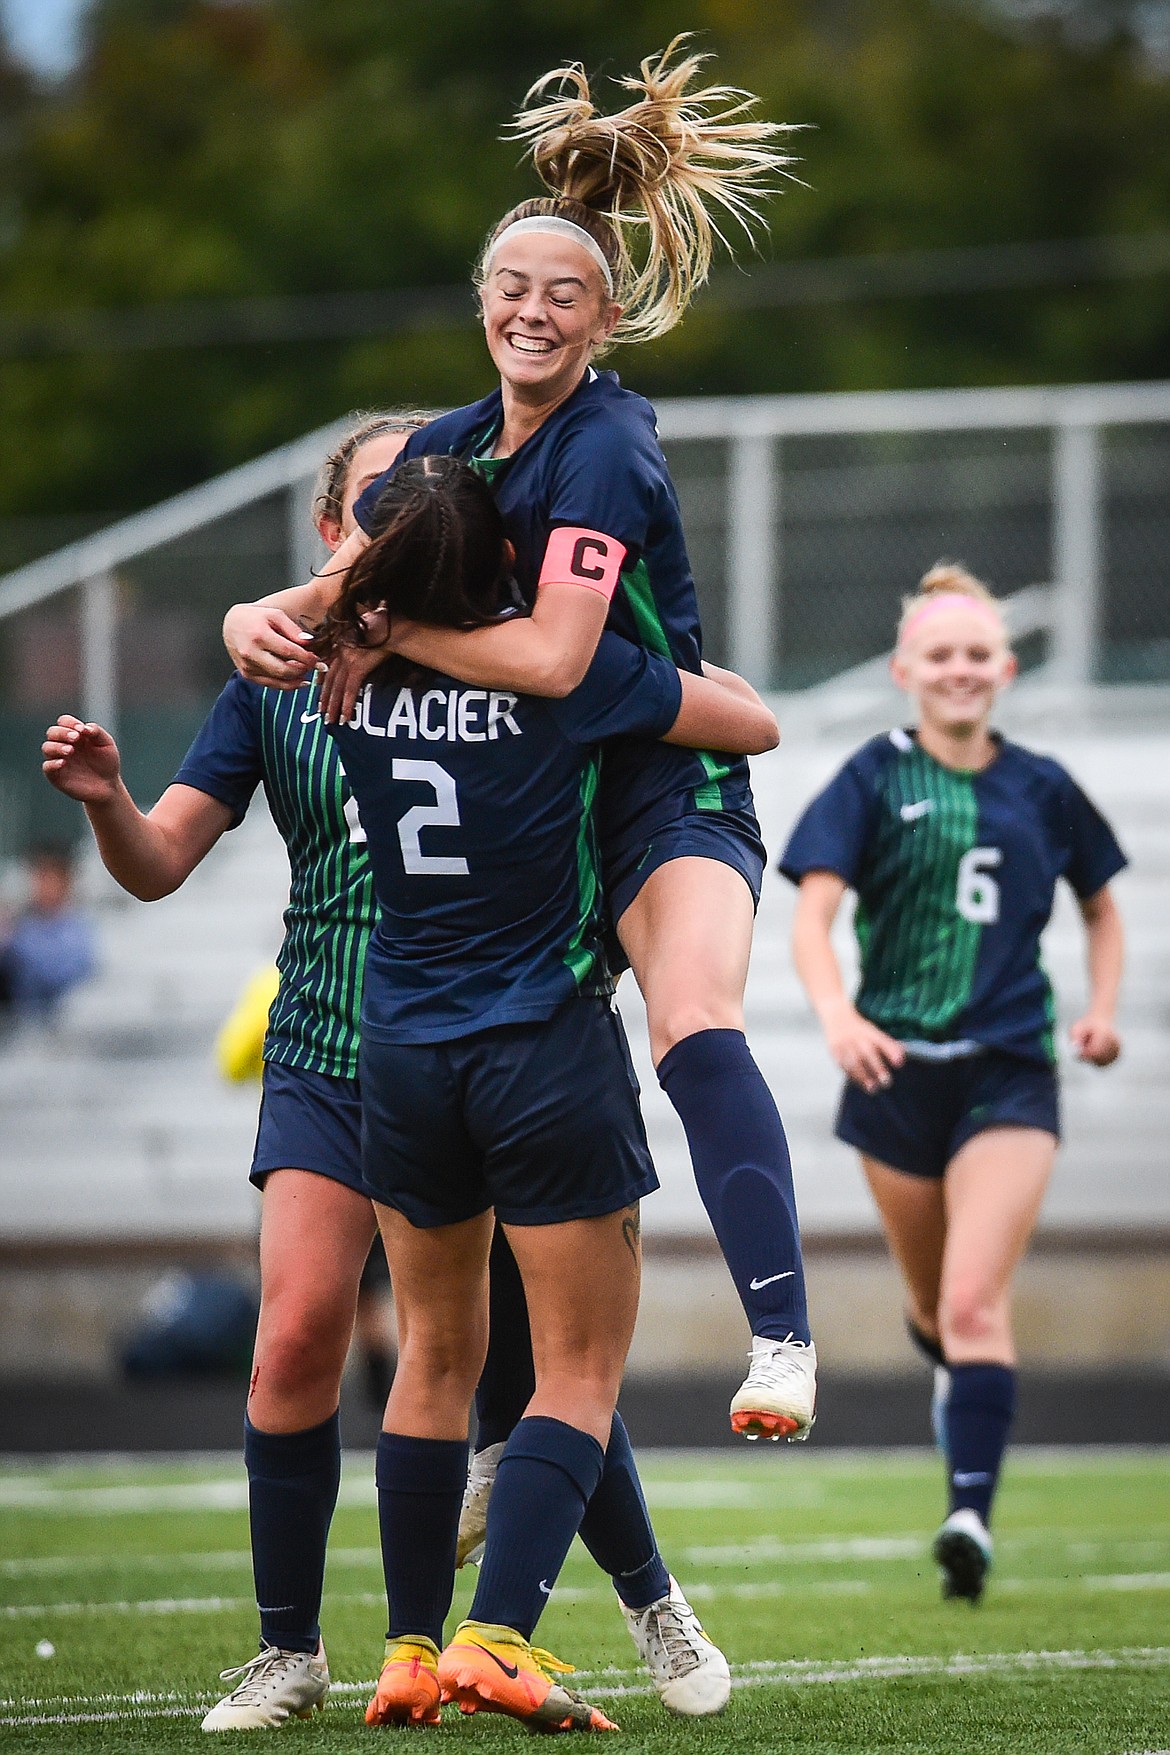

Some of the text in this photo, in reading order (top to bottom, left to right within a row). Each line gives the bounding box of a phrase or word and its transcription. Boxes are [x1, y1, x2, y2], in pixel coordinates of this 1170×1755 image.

[571, 537, 608, 581] C
[391, 758, 470, 875] 2
[957, 847, 1003, 924] 6
